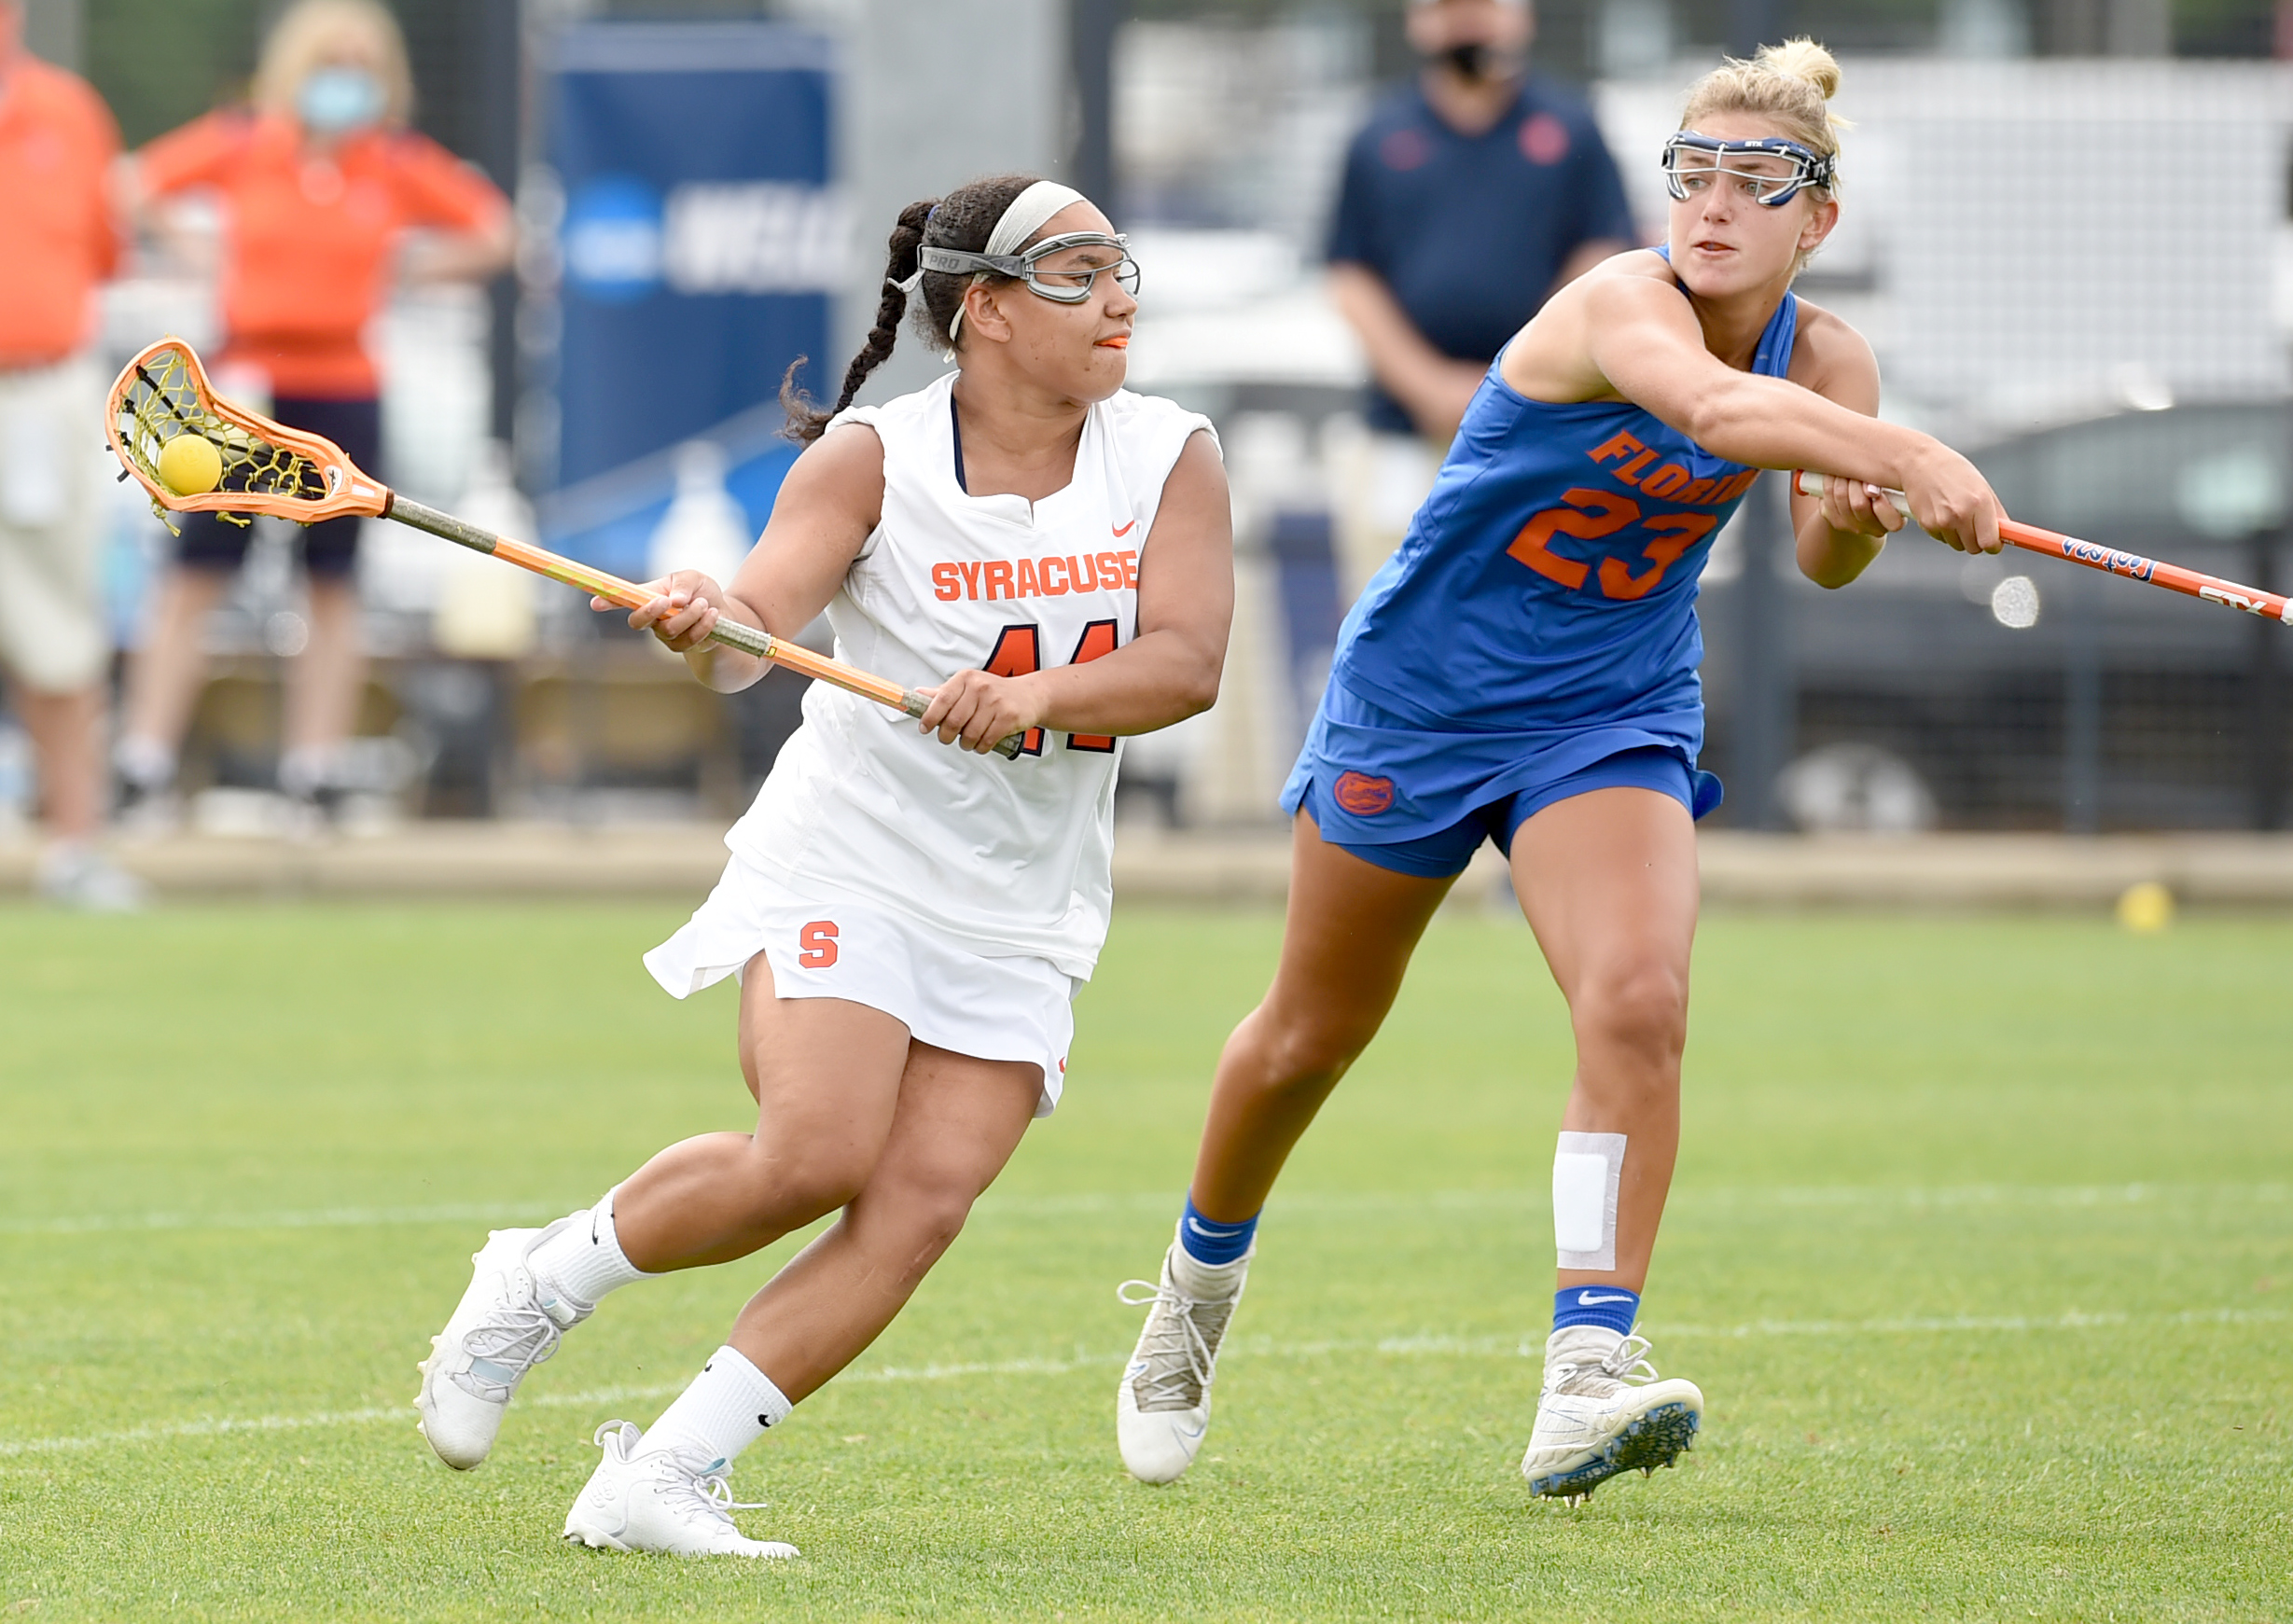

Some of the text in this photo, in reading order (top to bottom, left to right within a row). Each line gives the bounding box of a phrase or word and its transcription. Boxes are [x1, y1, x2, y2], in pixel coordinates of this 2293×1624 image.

[929, 255, 960, 270] PRO
[1586, 428, 1761, 506] FLORID
[1506, 487, 1718, 601] 23
[932, 549, 1139, 602] SYRACUSE
[2199, 585, 2268, 617] STX
[799, 920, 840, 969] S
